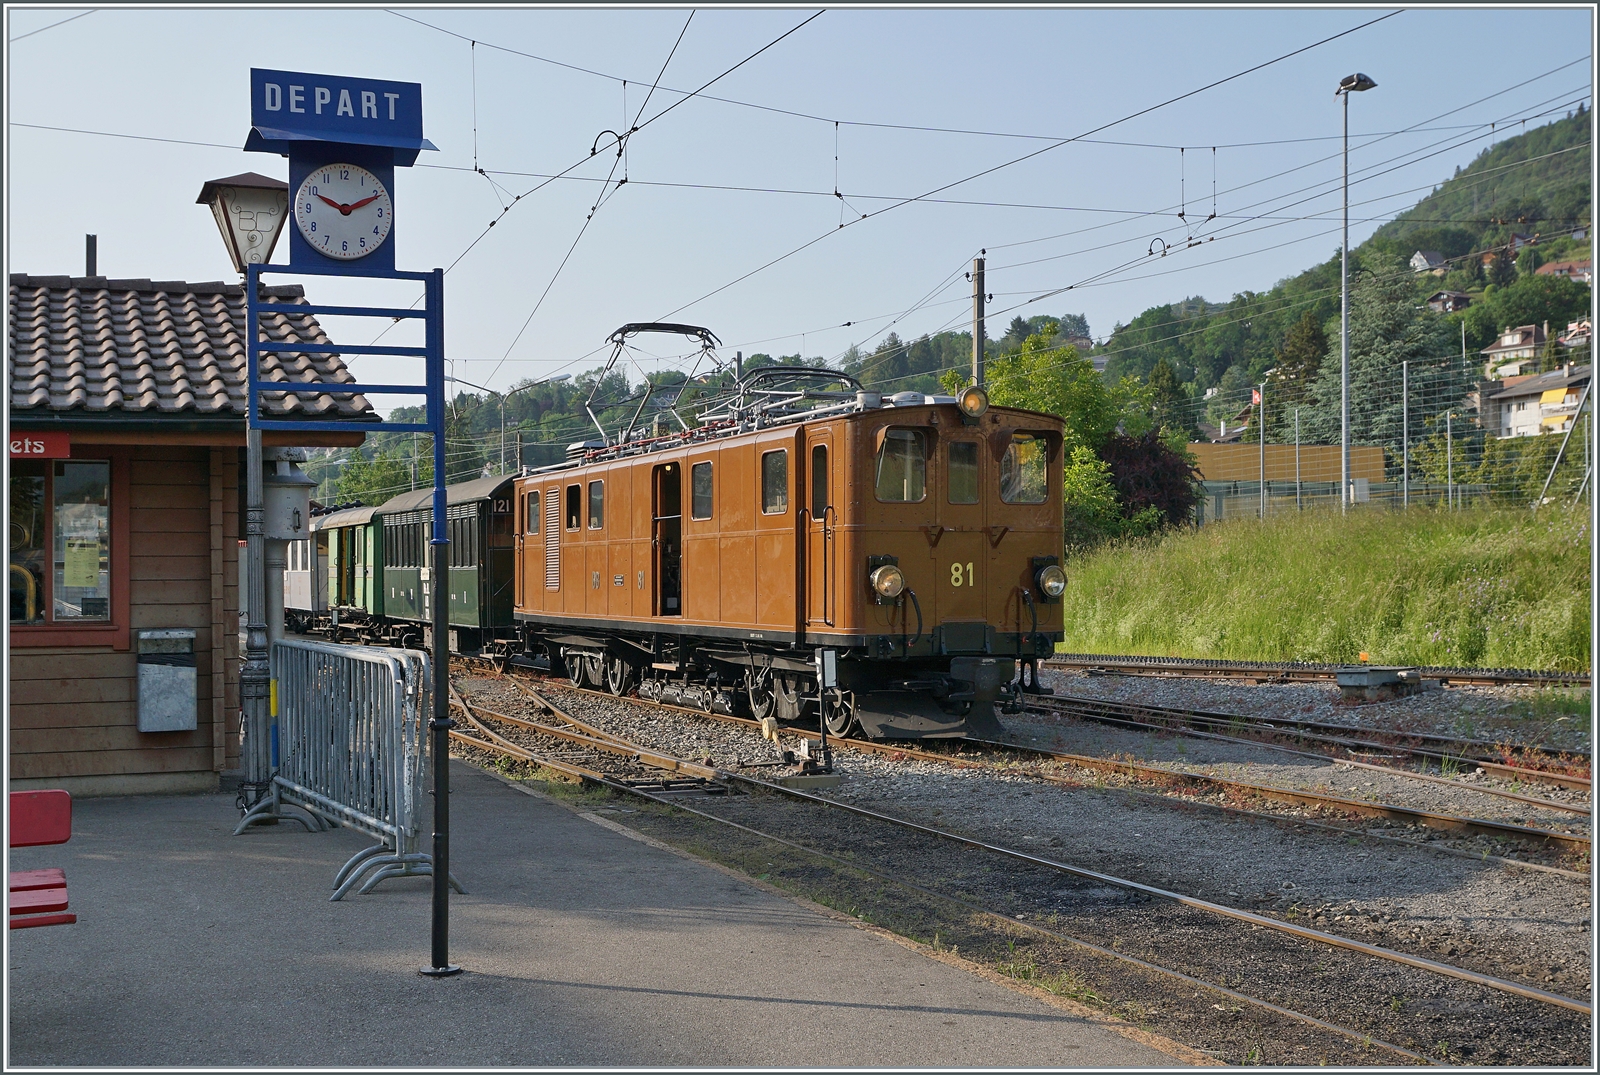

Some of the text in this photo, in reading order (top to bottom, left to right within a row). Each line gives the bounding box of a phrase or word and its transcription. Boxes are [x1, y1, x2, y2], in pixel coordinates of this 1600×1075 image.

[265, 83, 399, 120] DEPART
[323, 173, 330, 184] 11
[340, 169, 349, 181] 12
[361, 176, 364, 186] 1
[308, 186, 318, 196] 10
[305, 203, 312, 214] 9
[377, 208, 383, 218] 3
[310, 221, 317, 232] 8
[372, 225, 379, 236] 4
[324, 235, 330, 246] 7
[341, 240, 348, 252] 6
[359, 237, 366, 248] 5
[10, 437, 45, 454] ets
[493, 499, 510, 513] 121
[950, 562, 974, 587] 81
